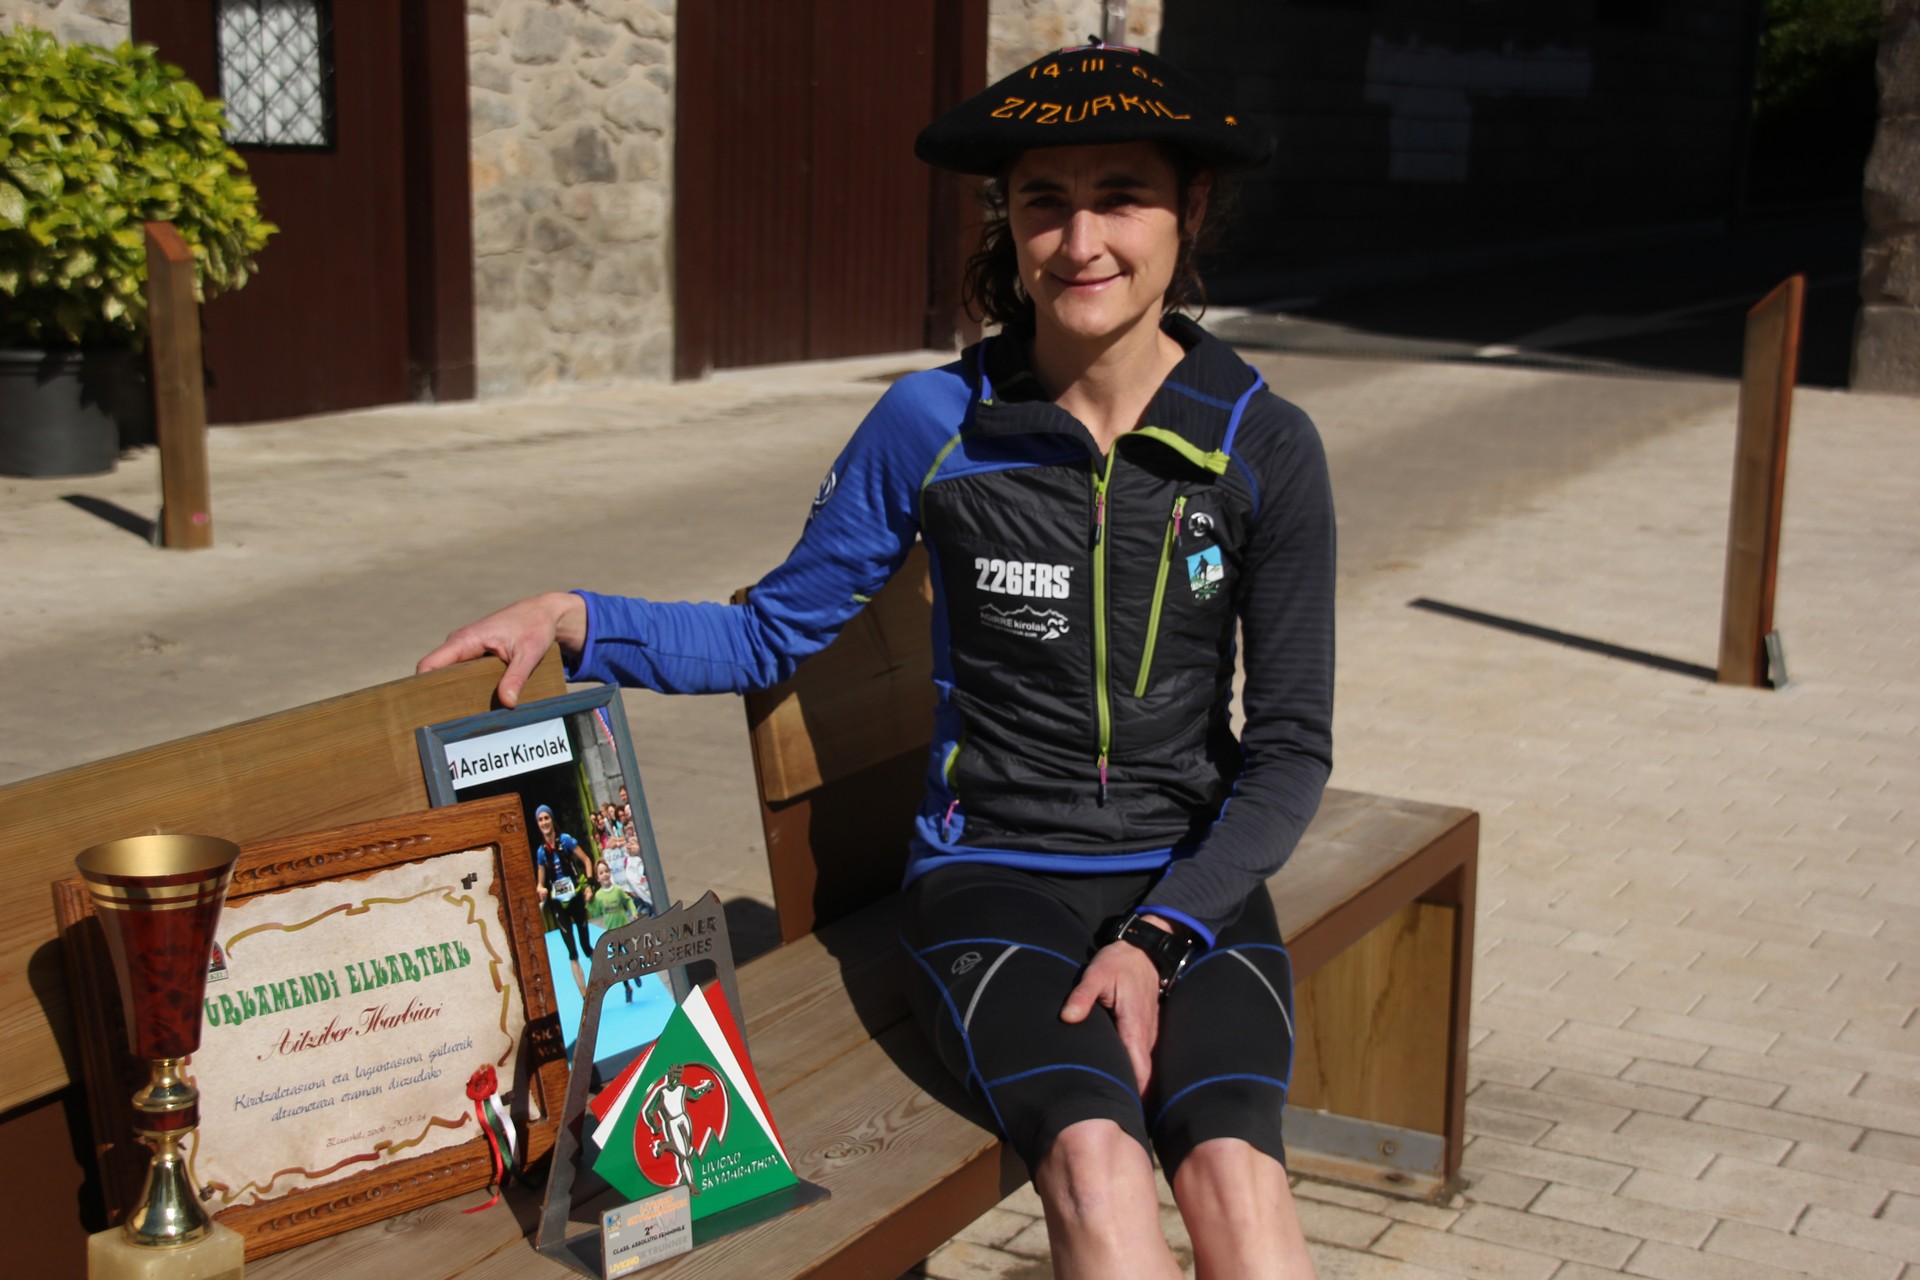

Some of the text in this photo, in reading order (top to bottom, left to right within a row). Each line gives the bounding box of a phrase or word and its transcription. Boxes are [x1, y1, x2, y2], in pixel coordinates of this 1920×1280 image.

[990, 93, 1192, 125] ZIZURKIL
[974, 557, 1071, 600] 226ERS
[1013, 619, 1048, 633] kirolak
[607, 916, 718, 960] SKYRUNNER
[667, 937, 713, 964] SERIES
[345, 939, 472, 995] ELKARTEAK
[257, 1015, 353, 1061] Aitziber
[332, 1072, 350, 1085] eta
[355, 1051, 424, 1080] laguntasuna
[702, 1151, 742, 1176] LIVIGNO
